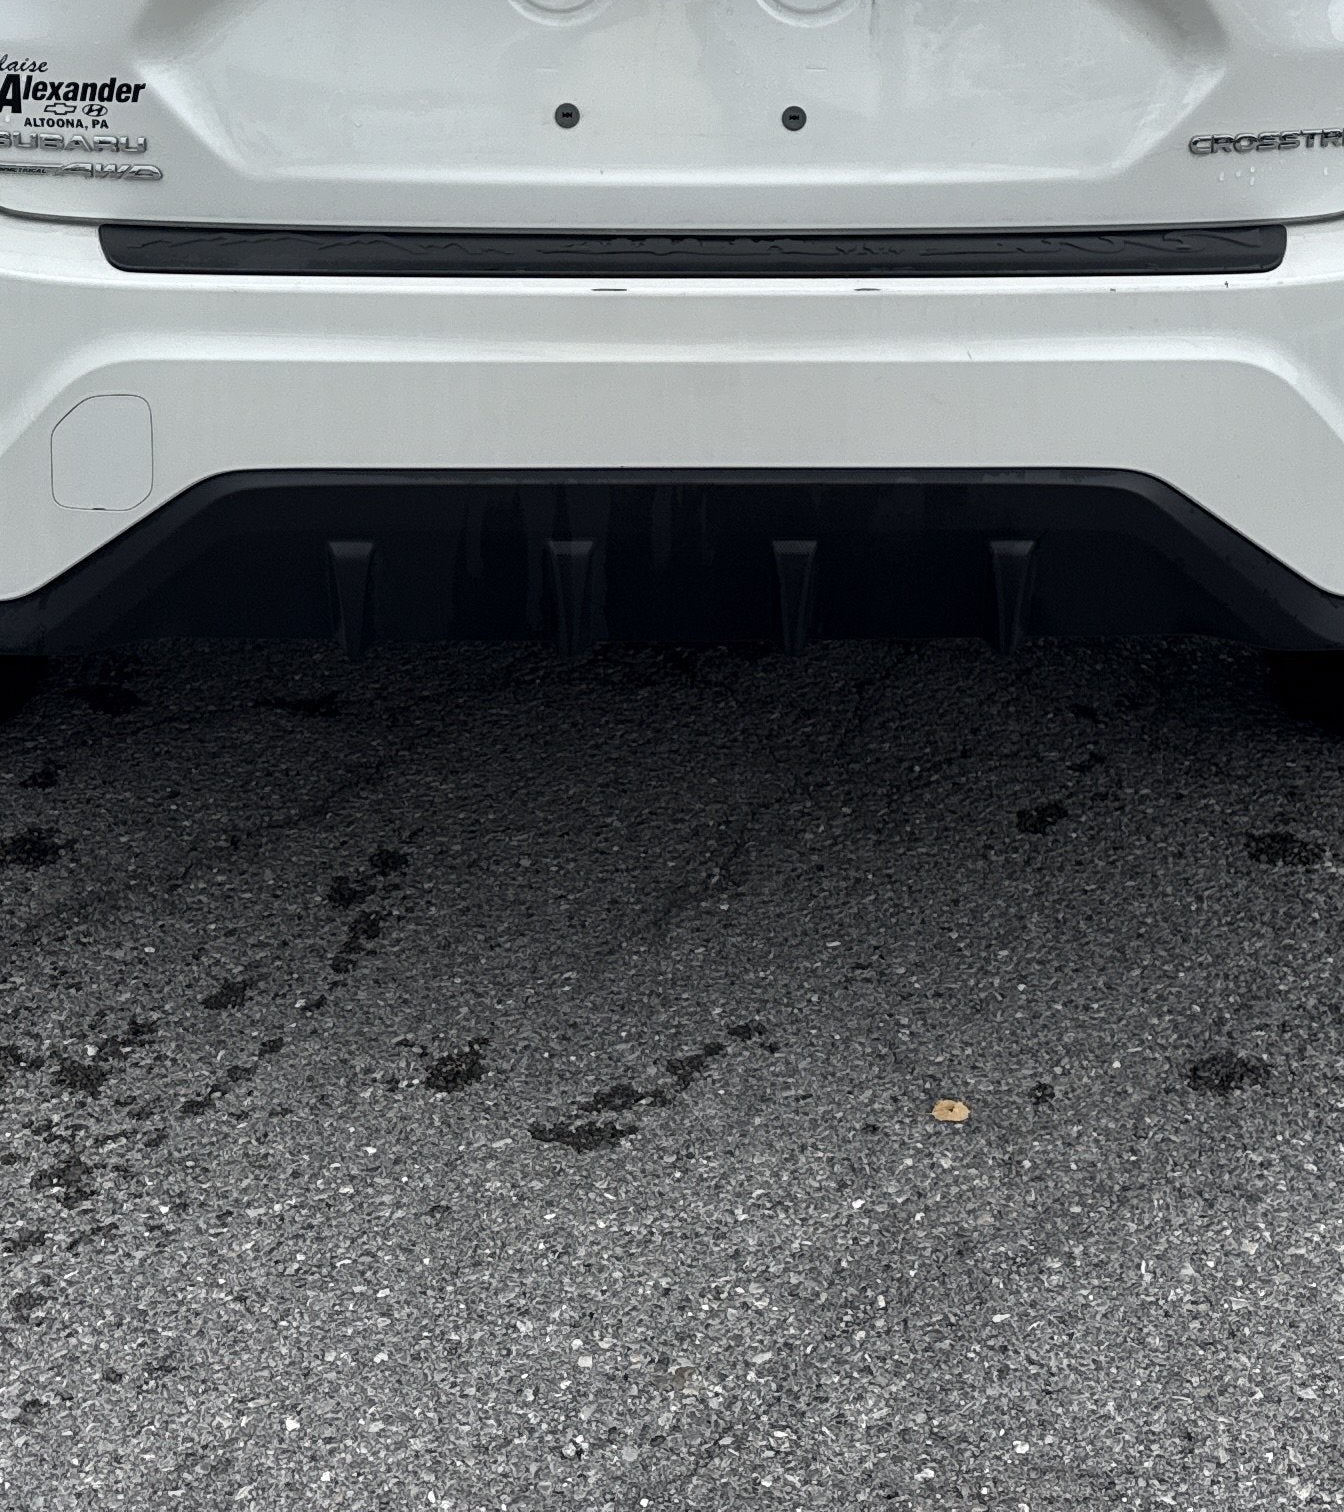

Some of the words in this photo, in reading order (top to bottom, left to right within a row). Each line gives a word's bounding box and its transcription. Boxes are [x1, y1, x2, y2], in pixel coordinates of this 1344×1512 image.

[24, 117, 88, 130] ALTOONA,
[92, 119, 109, 129] PA
[58, 162, 163, 181] AWD
